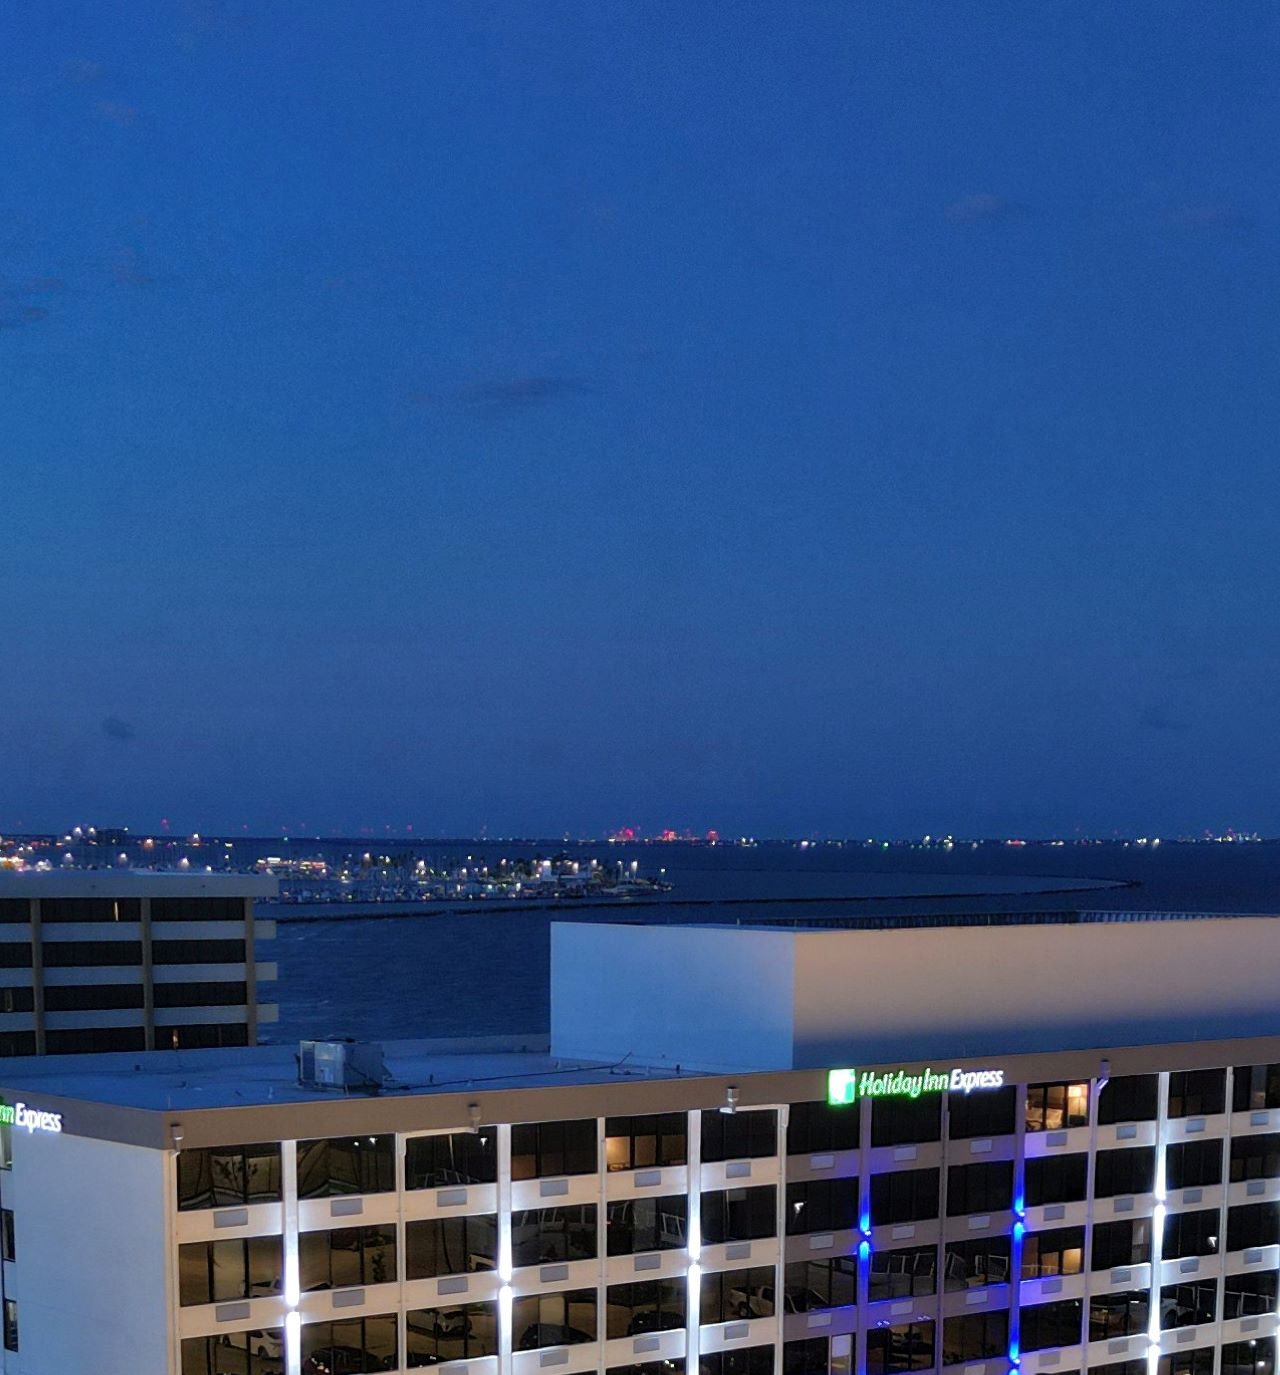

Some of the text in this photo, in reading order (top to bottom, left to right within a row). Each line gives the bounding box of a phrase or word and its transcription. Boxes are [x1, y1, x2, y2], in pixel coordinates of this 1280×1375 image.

[859, 1067, 1004, 1098] Holiday Inn Express
[15, 1102, 62, 1133] Express
